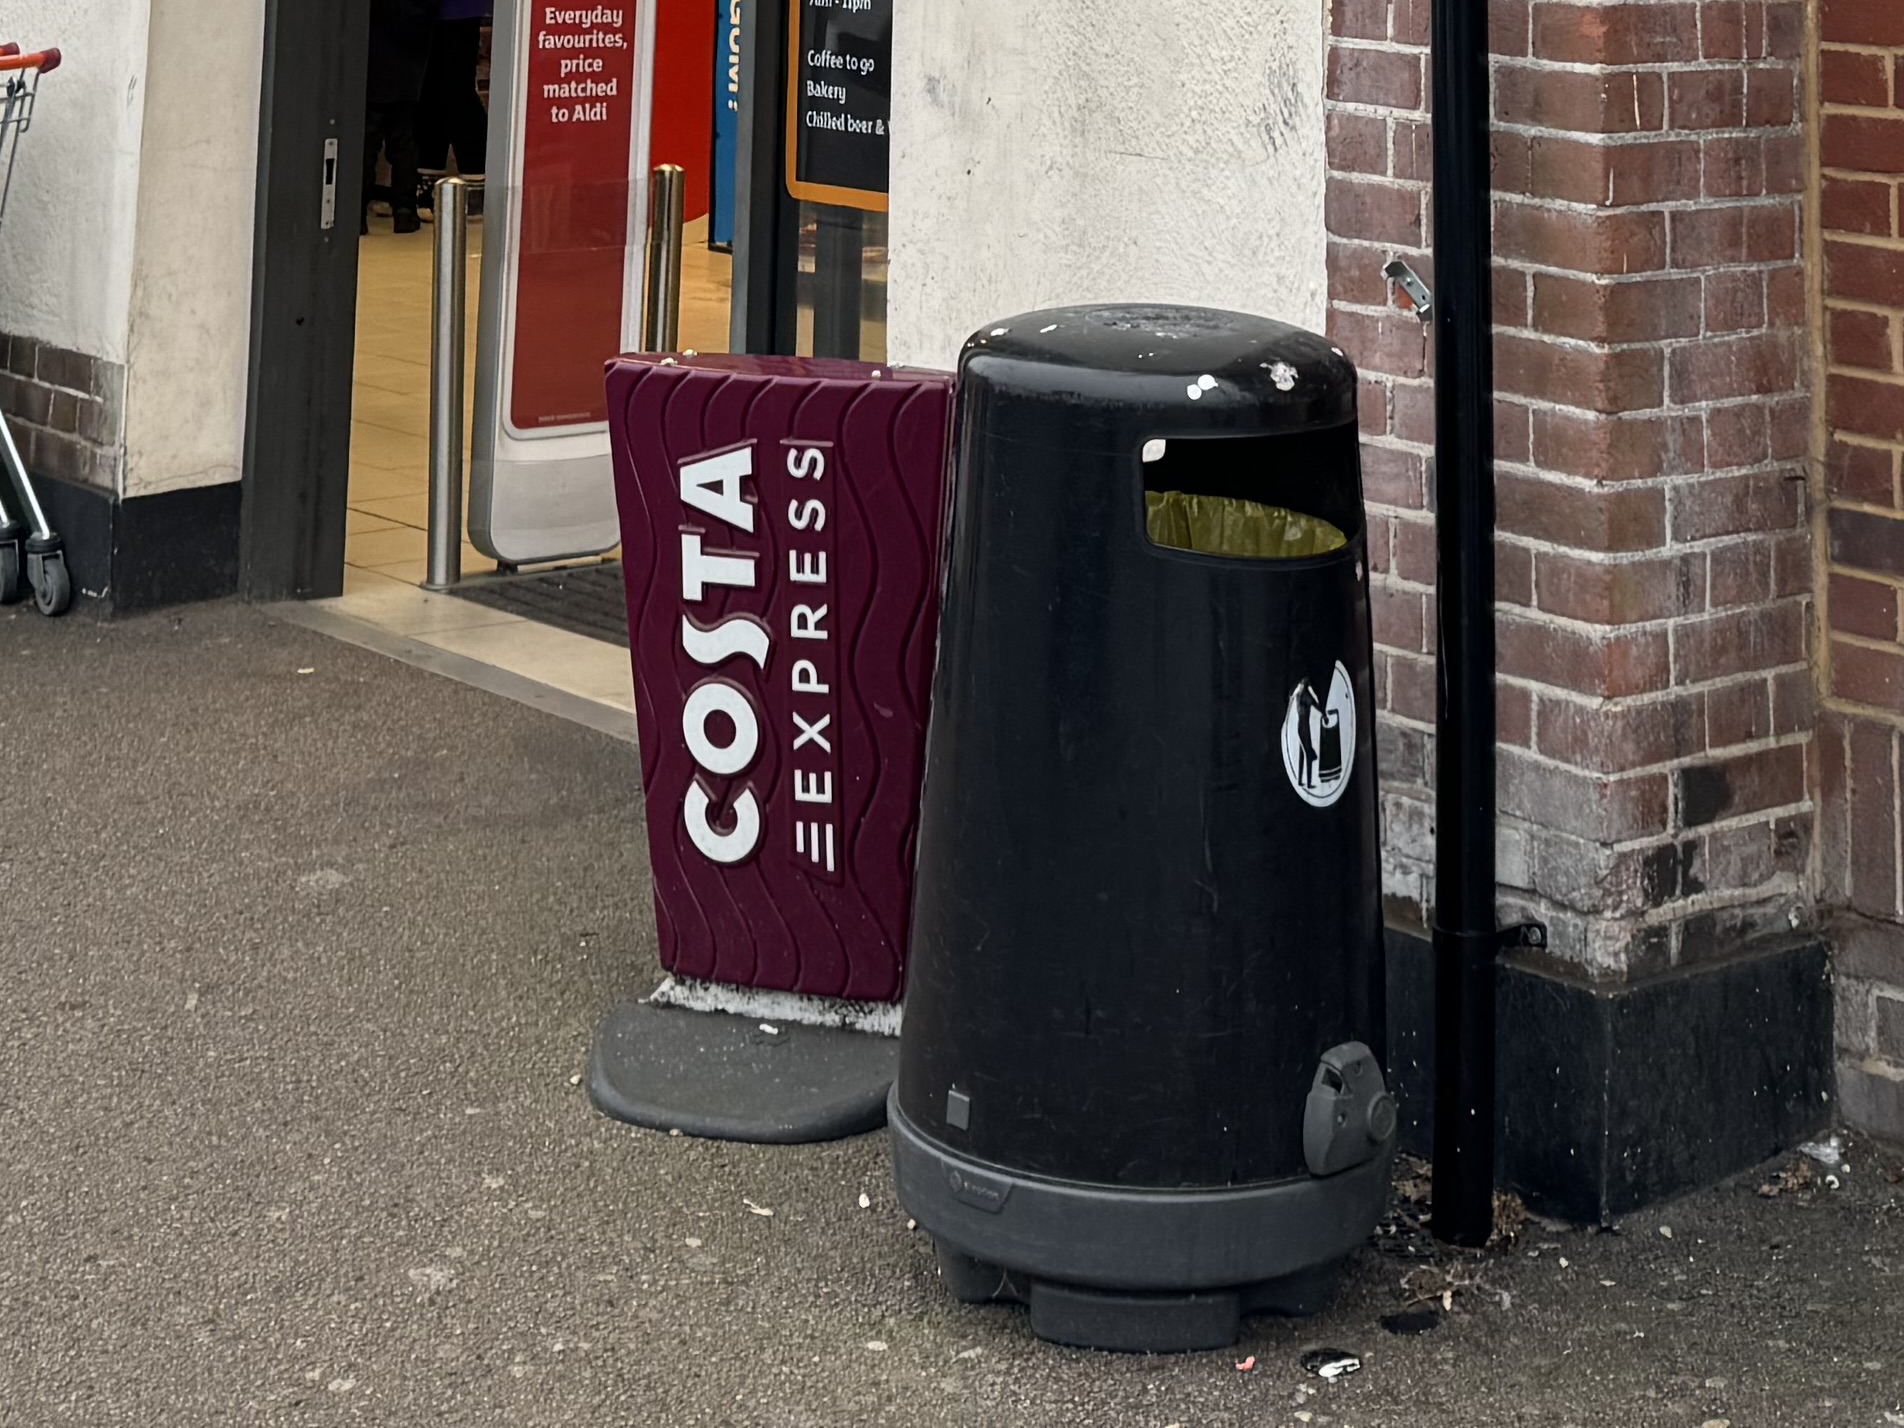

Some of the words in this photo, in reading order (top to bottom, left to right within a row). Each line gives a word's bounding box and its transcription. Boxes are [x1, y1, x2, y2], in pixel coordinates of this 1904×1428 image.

[545, 5, 623, 28] Everyday
[538, 29, 628, 50] favourites,
[561, 54, 603, 78] price
[807, 49, 843, 69] Coffee
[846, 54, 858, 70] to
[860, 58, 875, 75] go
[543, 78, 617, 98] matched
[807, 80, 846, 104] Bakery
[551, 105, 569, 123] to
[572, 102, 607, 122] Aldi
[806, 111, 845, 131] Chilled
[847, 114, 872, 134] beer
[875, 119, 885, 135] &
[787, 447, 833, 804] EXPRESS
[680, 445, 771, 866] COSTA
